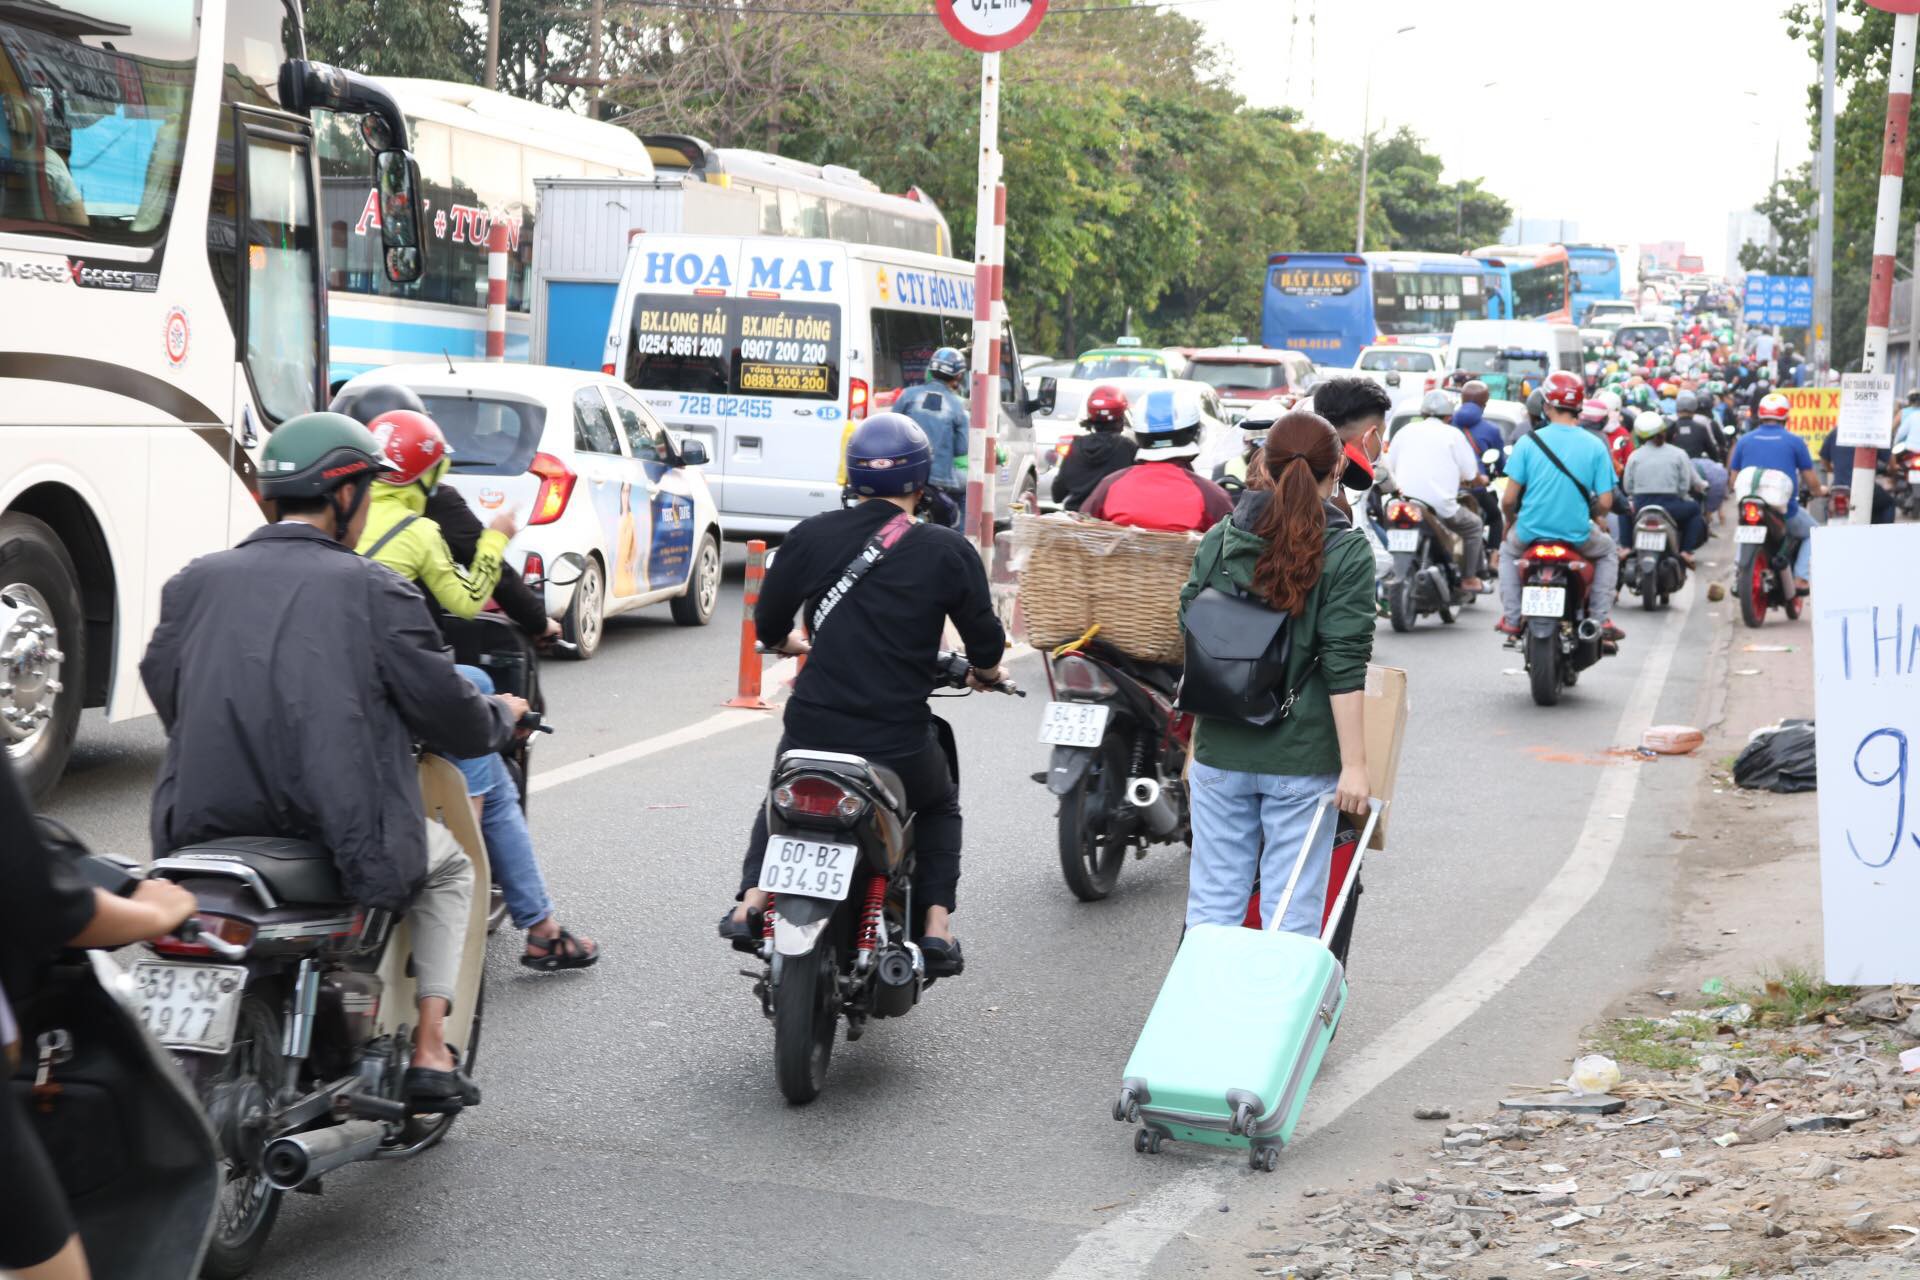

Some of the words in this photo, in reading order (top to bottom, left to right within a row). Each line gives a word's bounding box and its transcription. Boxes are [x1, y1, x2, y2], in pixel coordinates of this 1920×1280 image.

[644, 252, 732, 286] HOA
[749, 256, 834, 292] MAI
[928, 275, 958, 309] HOA
[640, 311, 699, 334] BX.LONG
[702, 307, 727, 335] HẢI
[795, 316, 831, 341] ĐÔNG
[638, 334, 668, 354] 0254
[669, 336, 698, 356] 3661
[699, 337, 723, 358] 200
[740, 338, 773, 360] 0907
[775, 341, 799, 362] 200
[801, 344, 827, 364] 200
[743, 373, 825, 390] 0889.200.200
[781, 841, 841, 870] 60-B2
[766, 865, 844, 895] 034.95
